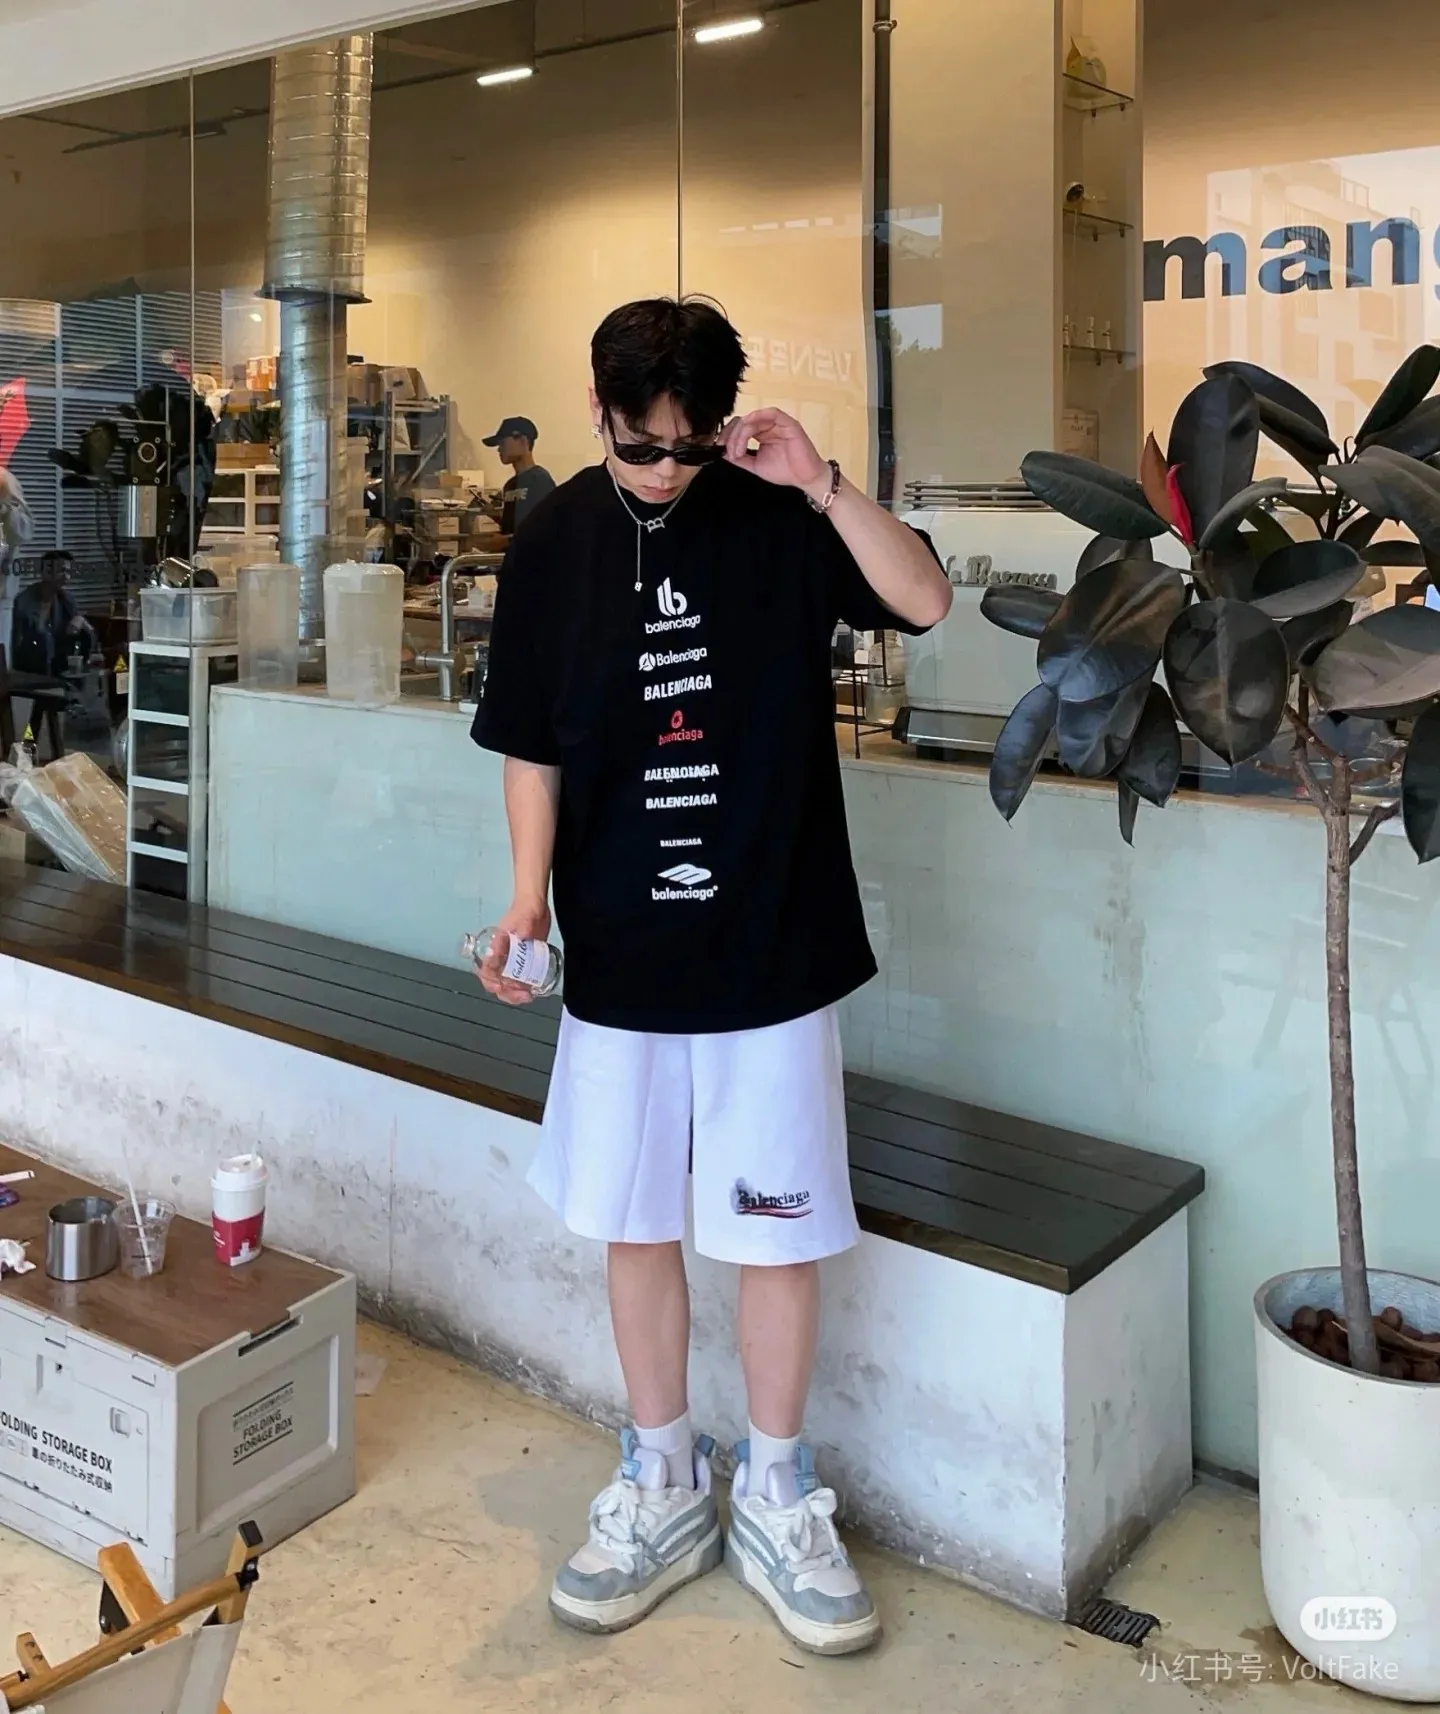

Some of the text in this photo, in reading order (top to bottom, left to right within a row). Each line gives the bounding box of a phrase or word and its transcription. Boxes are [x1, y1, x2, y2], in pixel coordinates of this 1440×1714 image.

[1143, 217, 1440, 303] man
[644, 674, 712, 701] BALENCIAGA
[646, 793, 717, 809] BALENCIAGA
[660, 838, 702, 847] BALENCIAGA
[233, 1415, 292, 1458] STORAGE BOX
[243, 1409, 282, 1440] FOLDING
[42, 1430, 88, 1463] STORAGE
[90, 1451, 112, 1473] BOX
